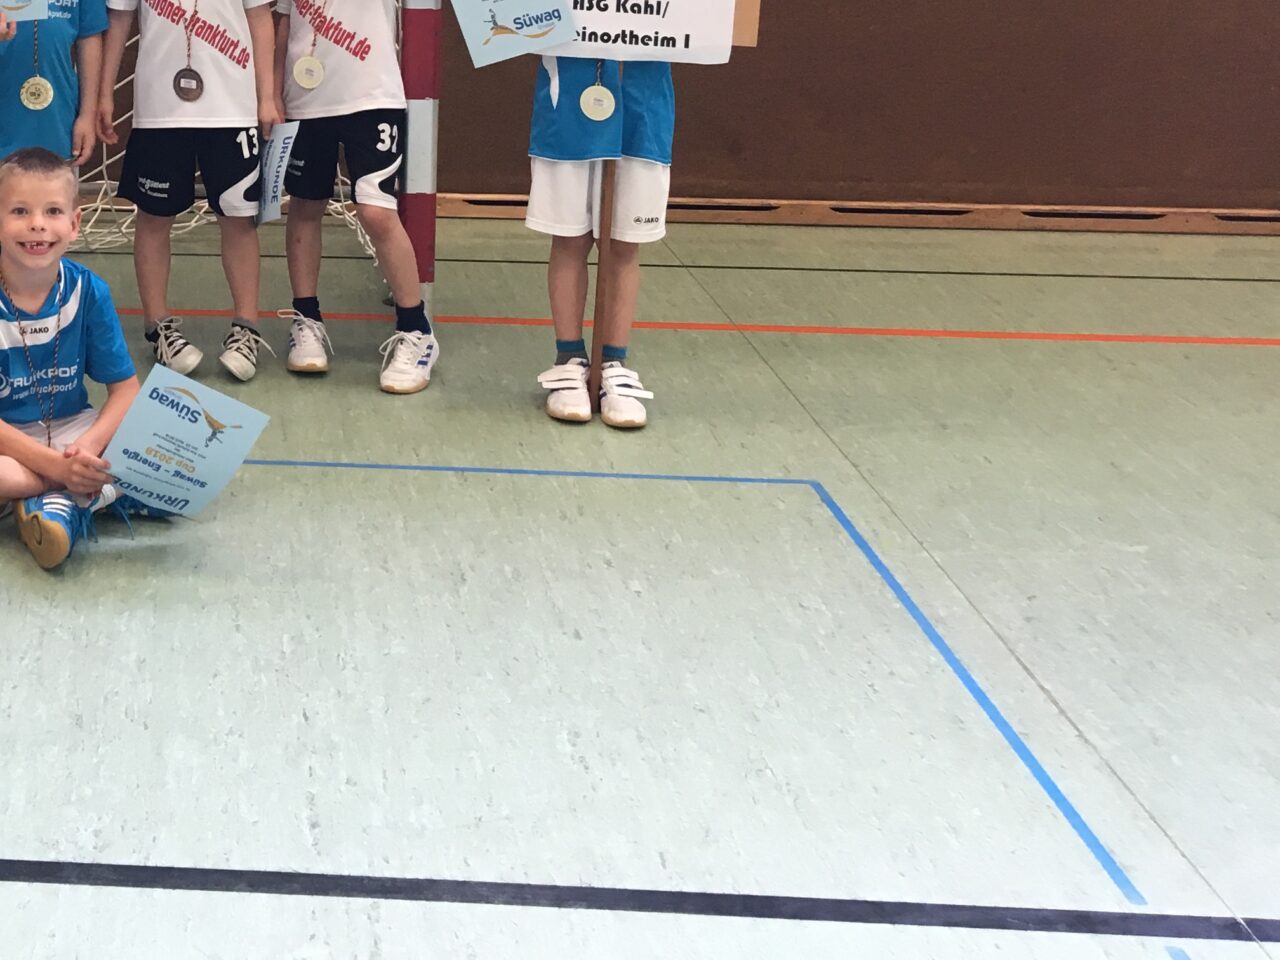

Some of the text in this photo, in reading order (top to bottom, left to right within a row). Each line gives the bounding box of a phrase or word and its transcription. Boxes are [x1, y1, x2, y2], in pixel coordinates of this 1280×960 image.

[513, 8, 562, 30] Süwag
[572, 26, 677, 48] inostheim
[235, 128, 259, 159] 13
[271, 136, 293, 204] URKUNDE
[29, 326, 49, 334] JAKO
[148, 387, 202, 424] Süwag
[122, 448, 162, 472] Energie
[145, 446, 174, 465] 2018
[175, 460, 196, 474] Cup
[172, 469, 208, 489] Süwag
